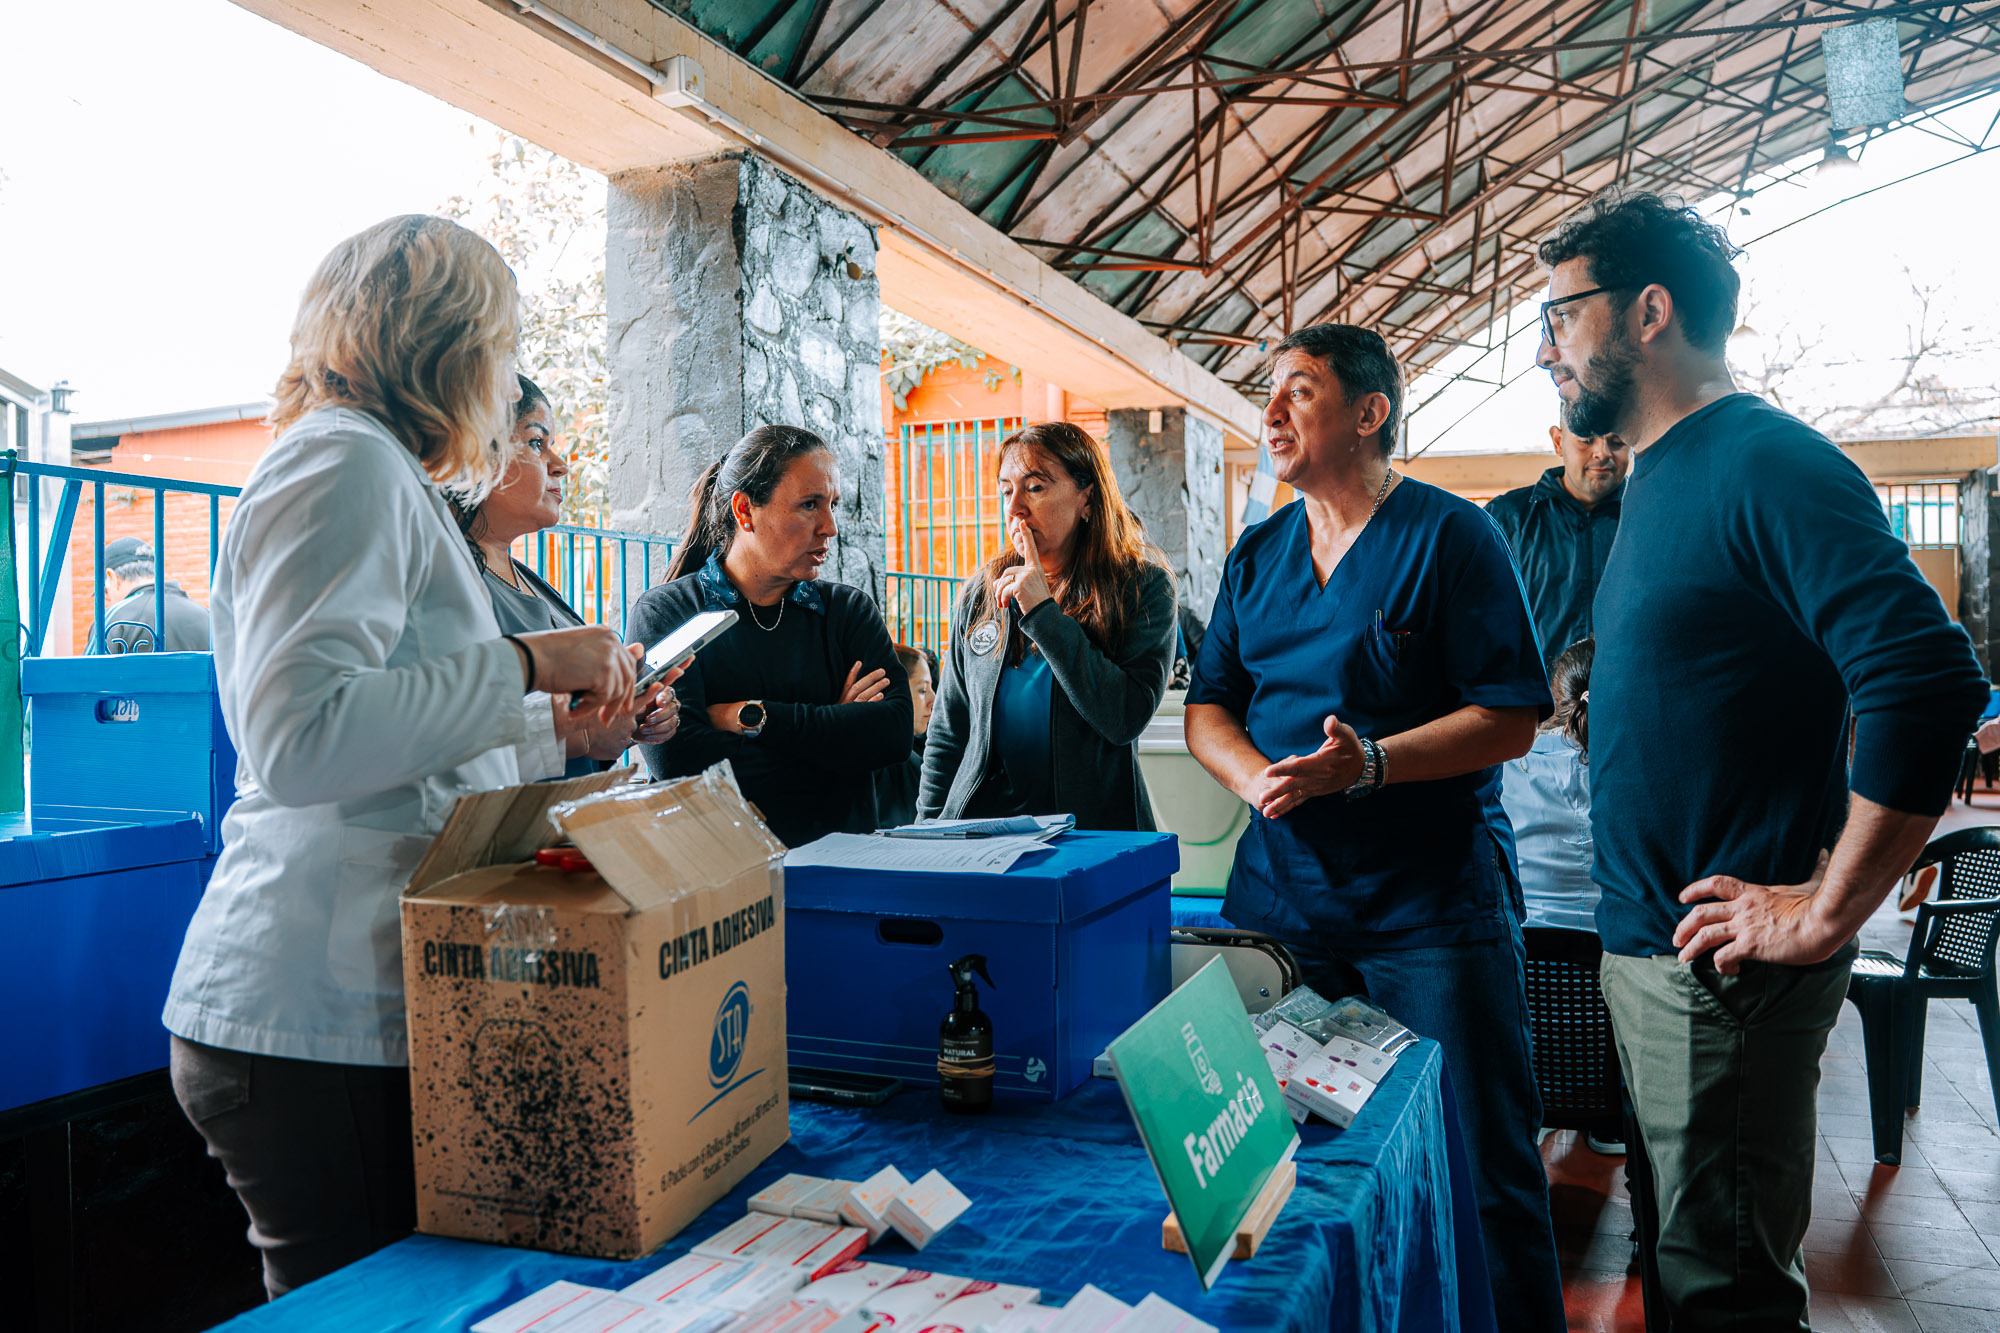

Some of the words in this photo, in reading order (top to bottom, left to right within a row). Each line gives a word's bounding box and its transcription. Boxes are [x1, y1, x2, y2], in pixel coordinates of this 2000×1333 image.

[658, 925, 710, 980] CINTA
[713, 895, 775, 958] ADHESIVA
[424, 940, 484, 980] CINTA
[489, 946, 600, 990] ADHESIVA
[943, 1047, 977, 1057] NATURAL
